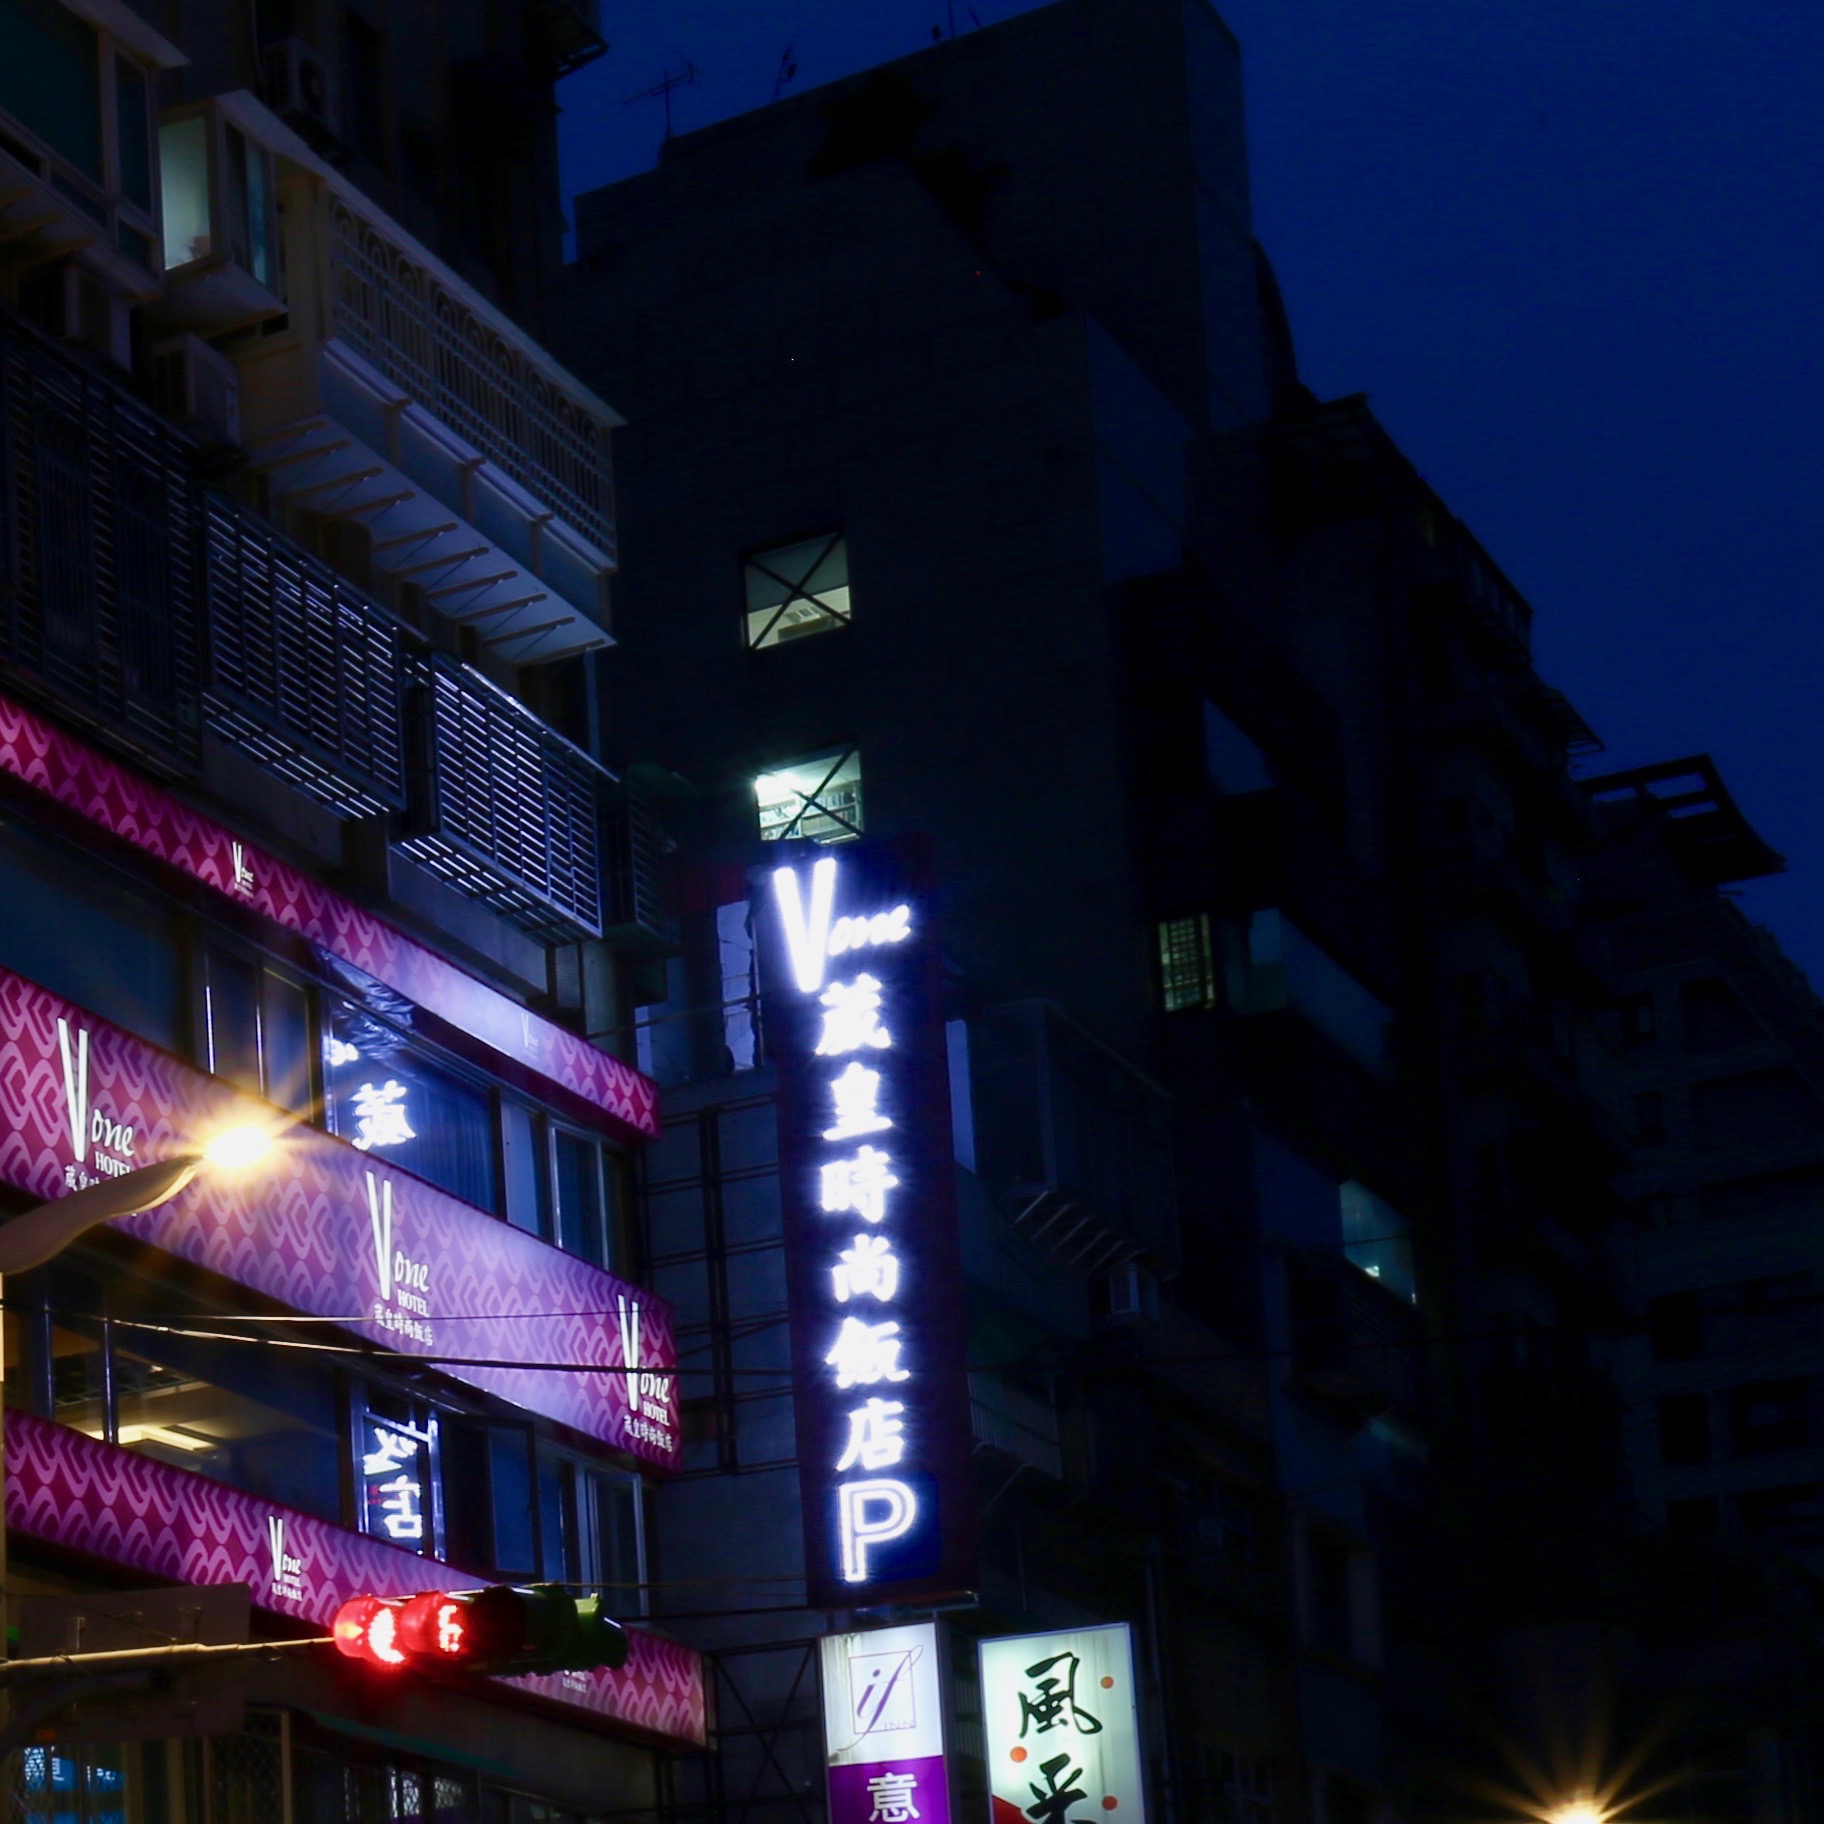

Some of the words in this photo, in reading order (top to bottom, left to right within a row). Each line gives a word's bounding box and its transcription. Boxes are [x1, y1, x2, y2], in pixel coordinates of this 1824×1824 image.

[396, 1288, 430, 1318] HOTEL
[643, 1399, 670, 1427] HOTEL
[834, 1476, 919, 1584] P
